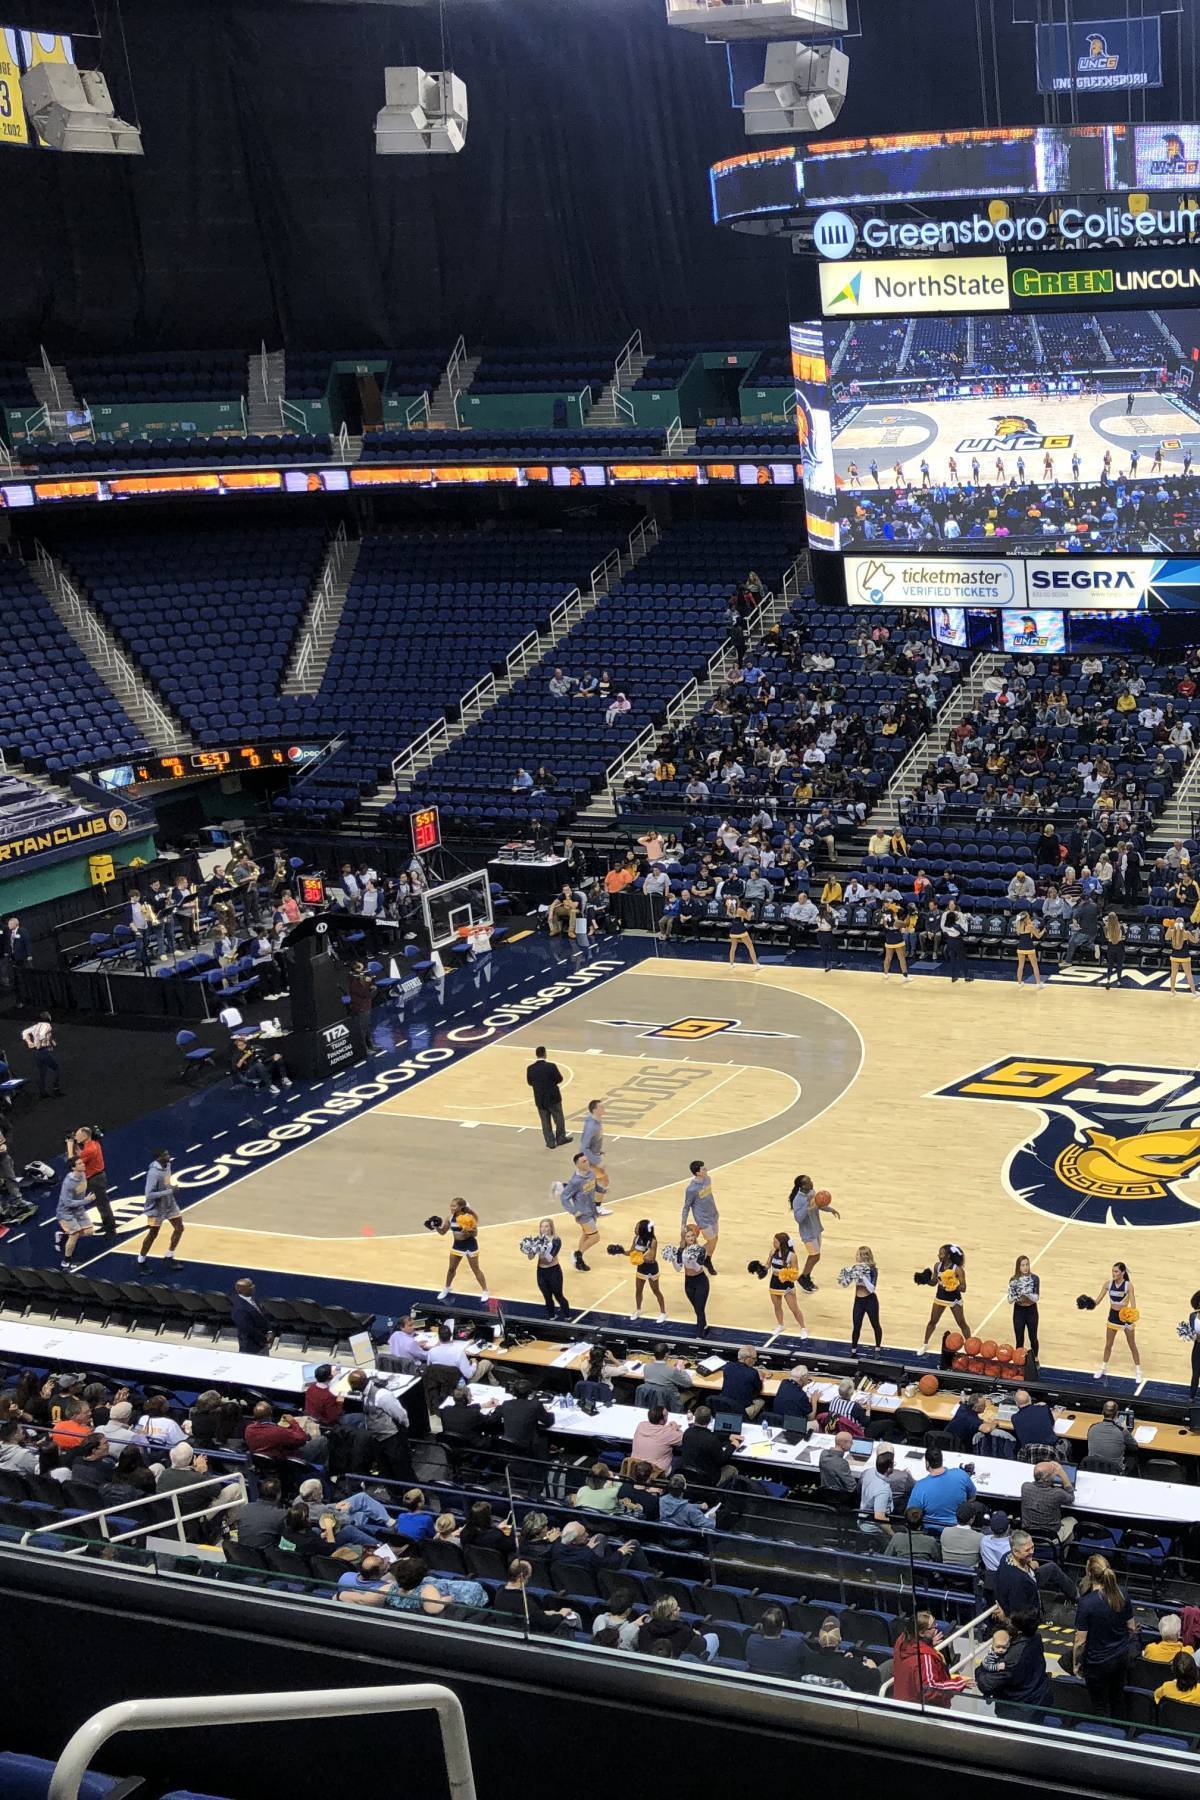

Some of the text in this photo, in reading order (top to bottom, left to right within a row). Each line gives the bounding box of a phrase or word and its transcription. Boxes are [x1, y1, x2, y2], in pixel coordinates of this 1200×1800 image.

[1079, 57, 1118, 71] UNCG
[1076, 73, 1148, 88] GREENSBORO
[863, 212, 1048, 248] Greensboro
[873, 273, 1005, 299] NorthState
[1012, 267, 1114, 298] GREEN
[954, 434, 1074, 453] UNCG
[902, 567, 1002, 585] ticketmaster
[1031, 570, 1135, 589] SEGRA
[902, 586, 999, 598] VERIFIED TICKETS
[1013, 634, 1049, 647] UNCG
[199, 752, 230, 766] 5:51
[251, 755, 260, 767] 0
[173, 764, 183, 777] 0
[415, 811, 435, 827] 5:51
[54, 817, 108, 845] CLUB
[416, 824, 436, 849] 30
[401, 976, 422, 993] DEFENSE
[323, 1024, 350, 1042] TFA
[327, 1044, 352, 1059] FINANCIAL
[331, 1039, 347, 1050] TRIAD
[330, 1051, 354, 1065] ADVISORS
[170, 959, 626, 1189] Greensboro Coliseum
